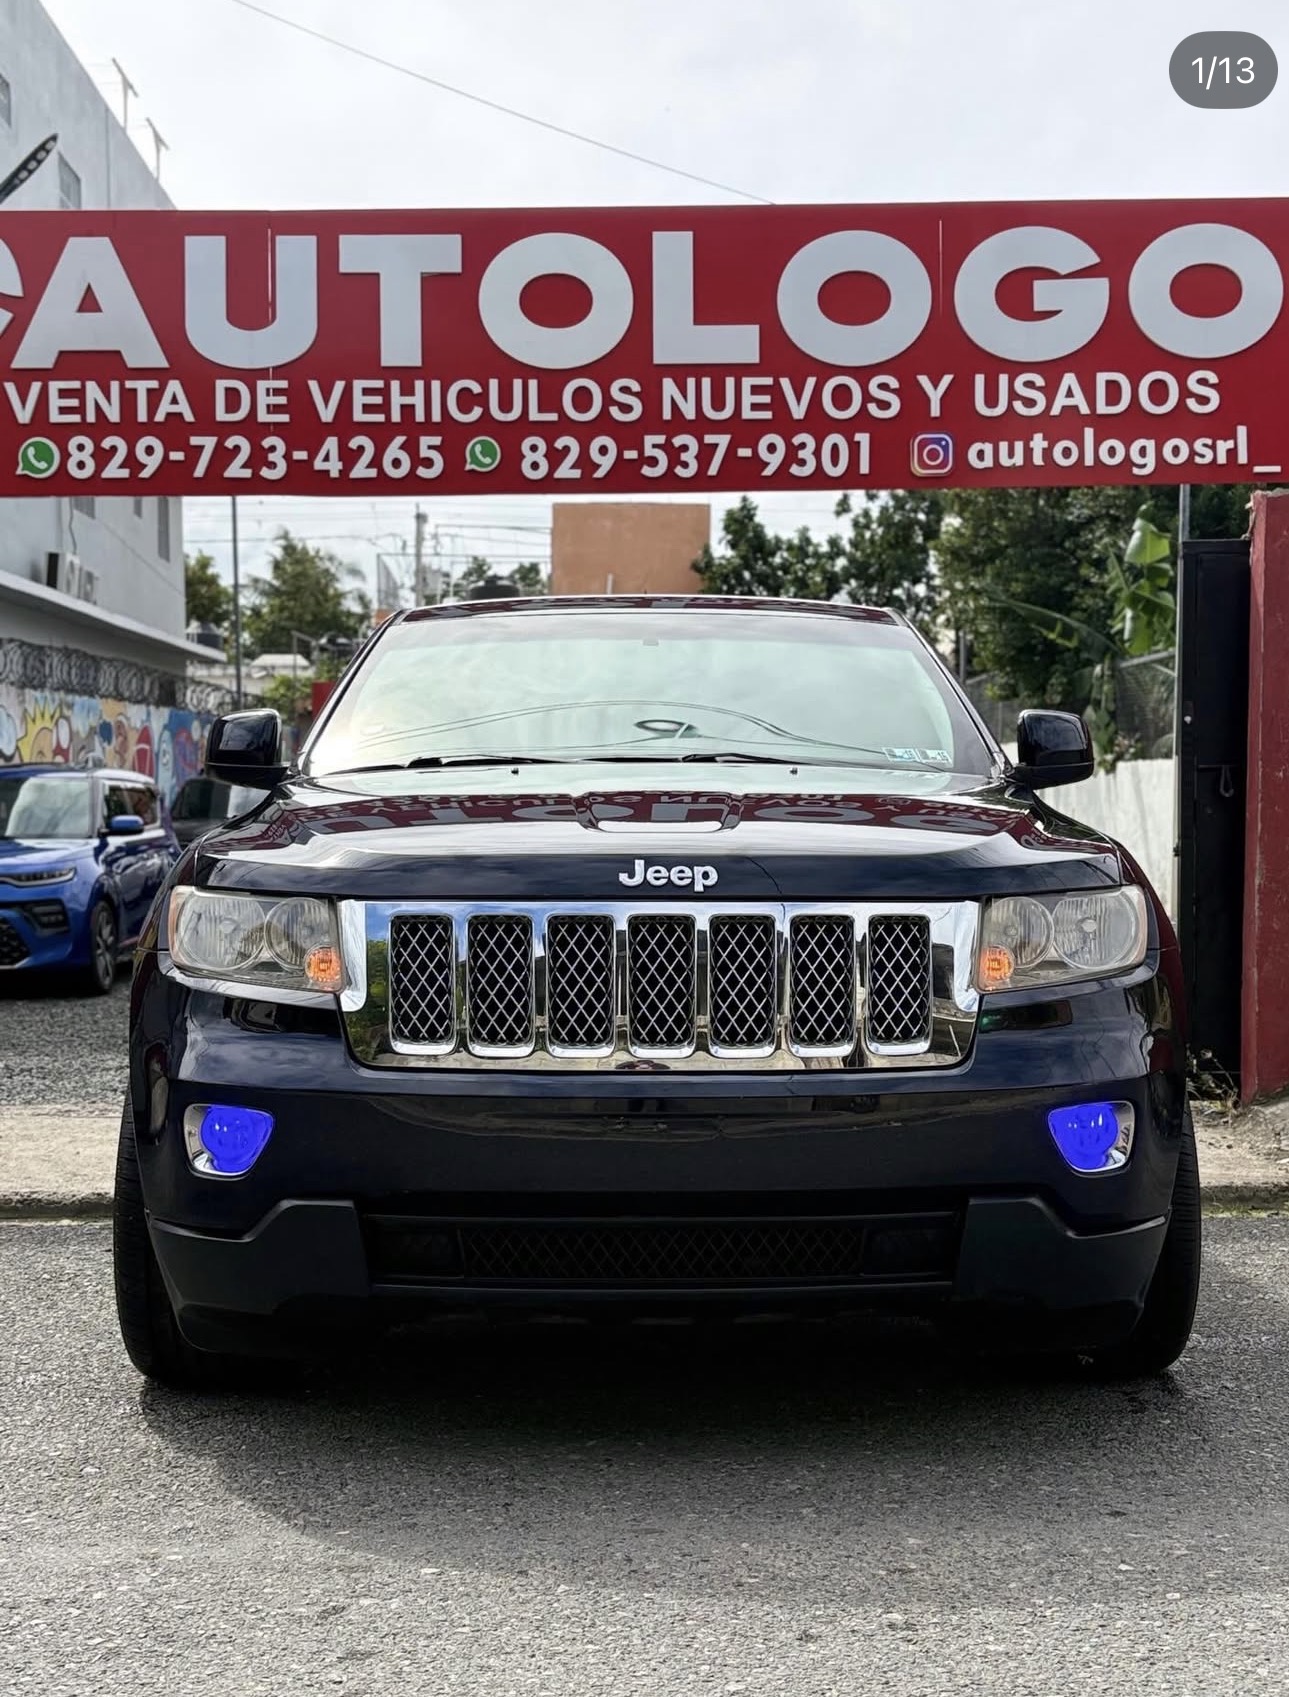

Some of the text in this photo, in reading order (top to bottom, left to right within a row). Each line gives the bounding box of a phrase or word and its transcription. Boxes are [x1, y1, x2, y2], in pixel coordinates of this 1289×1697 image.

[10, 222, 1284, 370] AUTOLOGO
[3, 369, 1220, 423] VENTA DE VEHICULOS NUEVOS Y USADOS
[66, 425, 1282, 480] 829-723-4265 829-537-9301 autologosrl_
[618, 859, 719, 893] Jeep
